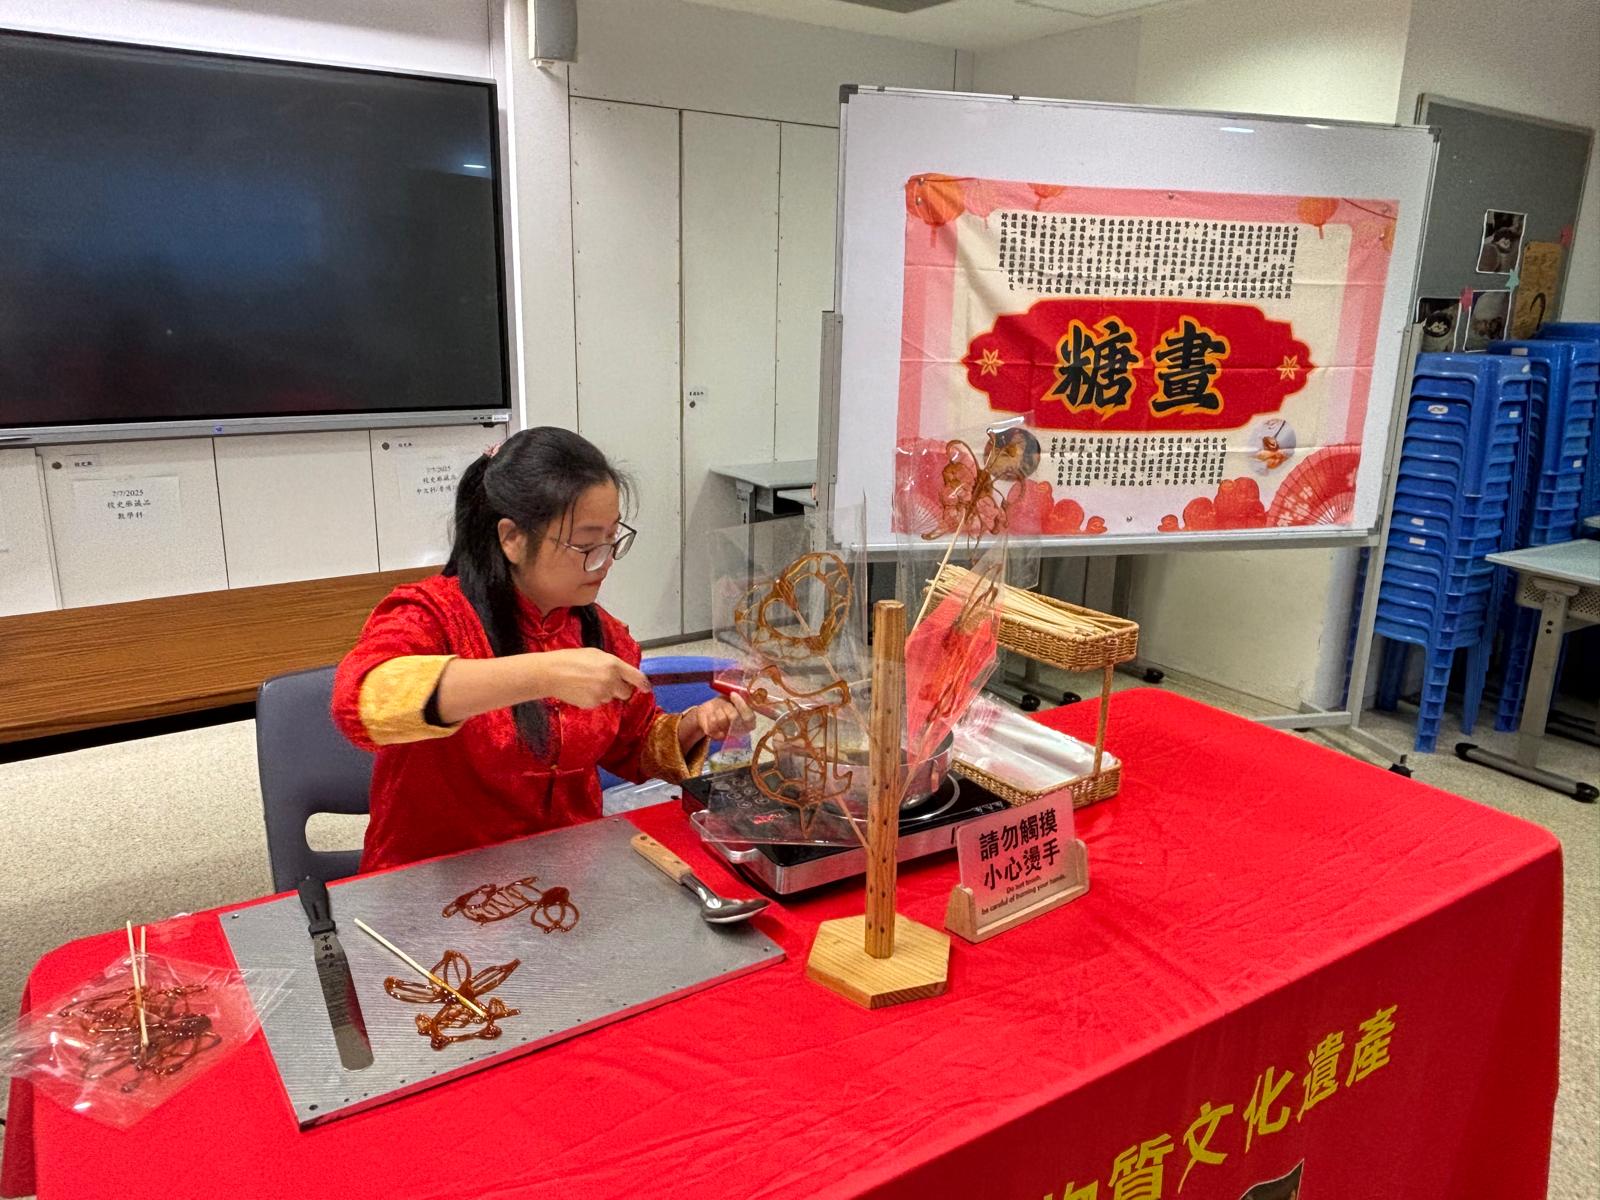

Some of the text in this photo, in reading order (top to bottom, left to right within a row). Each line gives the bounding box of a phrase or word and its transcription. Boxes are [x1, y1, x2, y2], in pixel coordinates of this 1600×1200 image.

[1051, 317, 1229, 417] 糖畫
[978, 808, 1058, 862] 請勿觸摸
[984, 838, 1060, 890] 小心燙手
[1043, 1004, 1398, 1200] 質文化遺產
